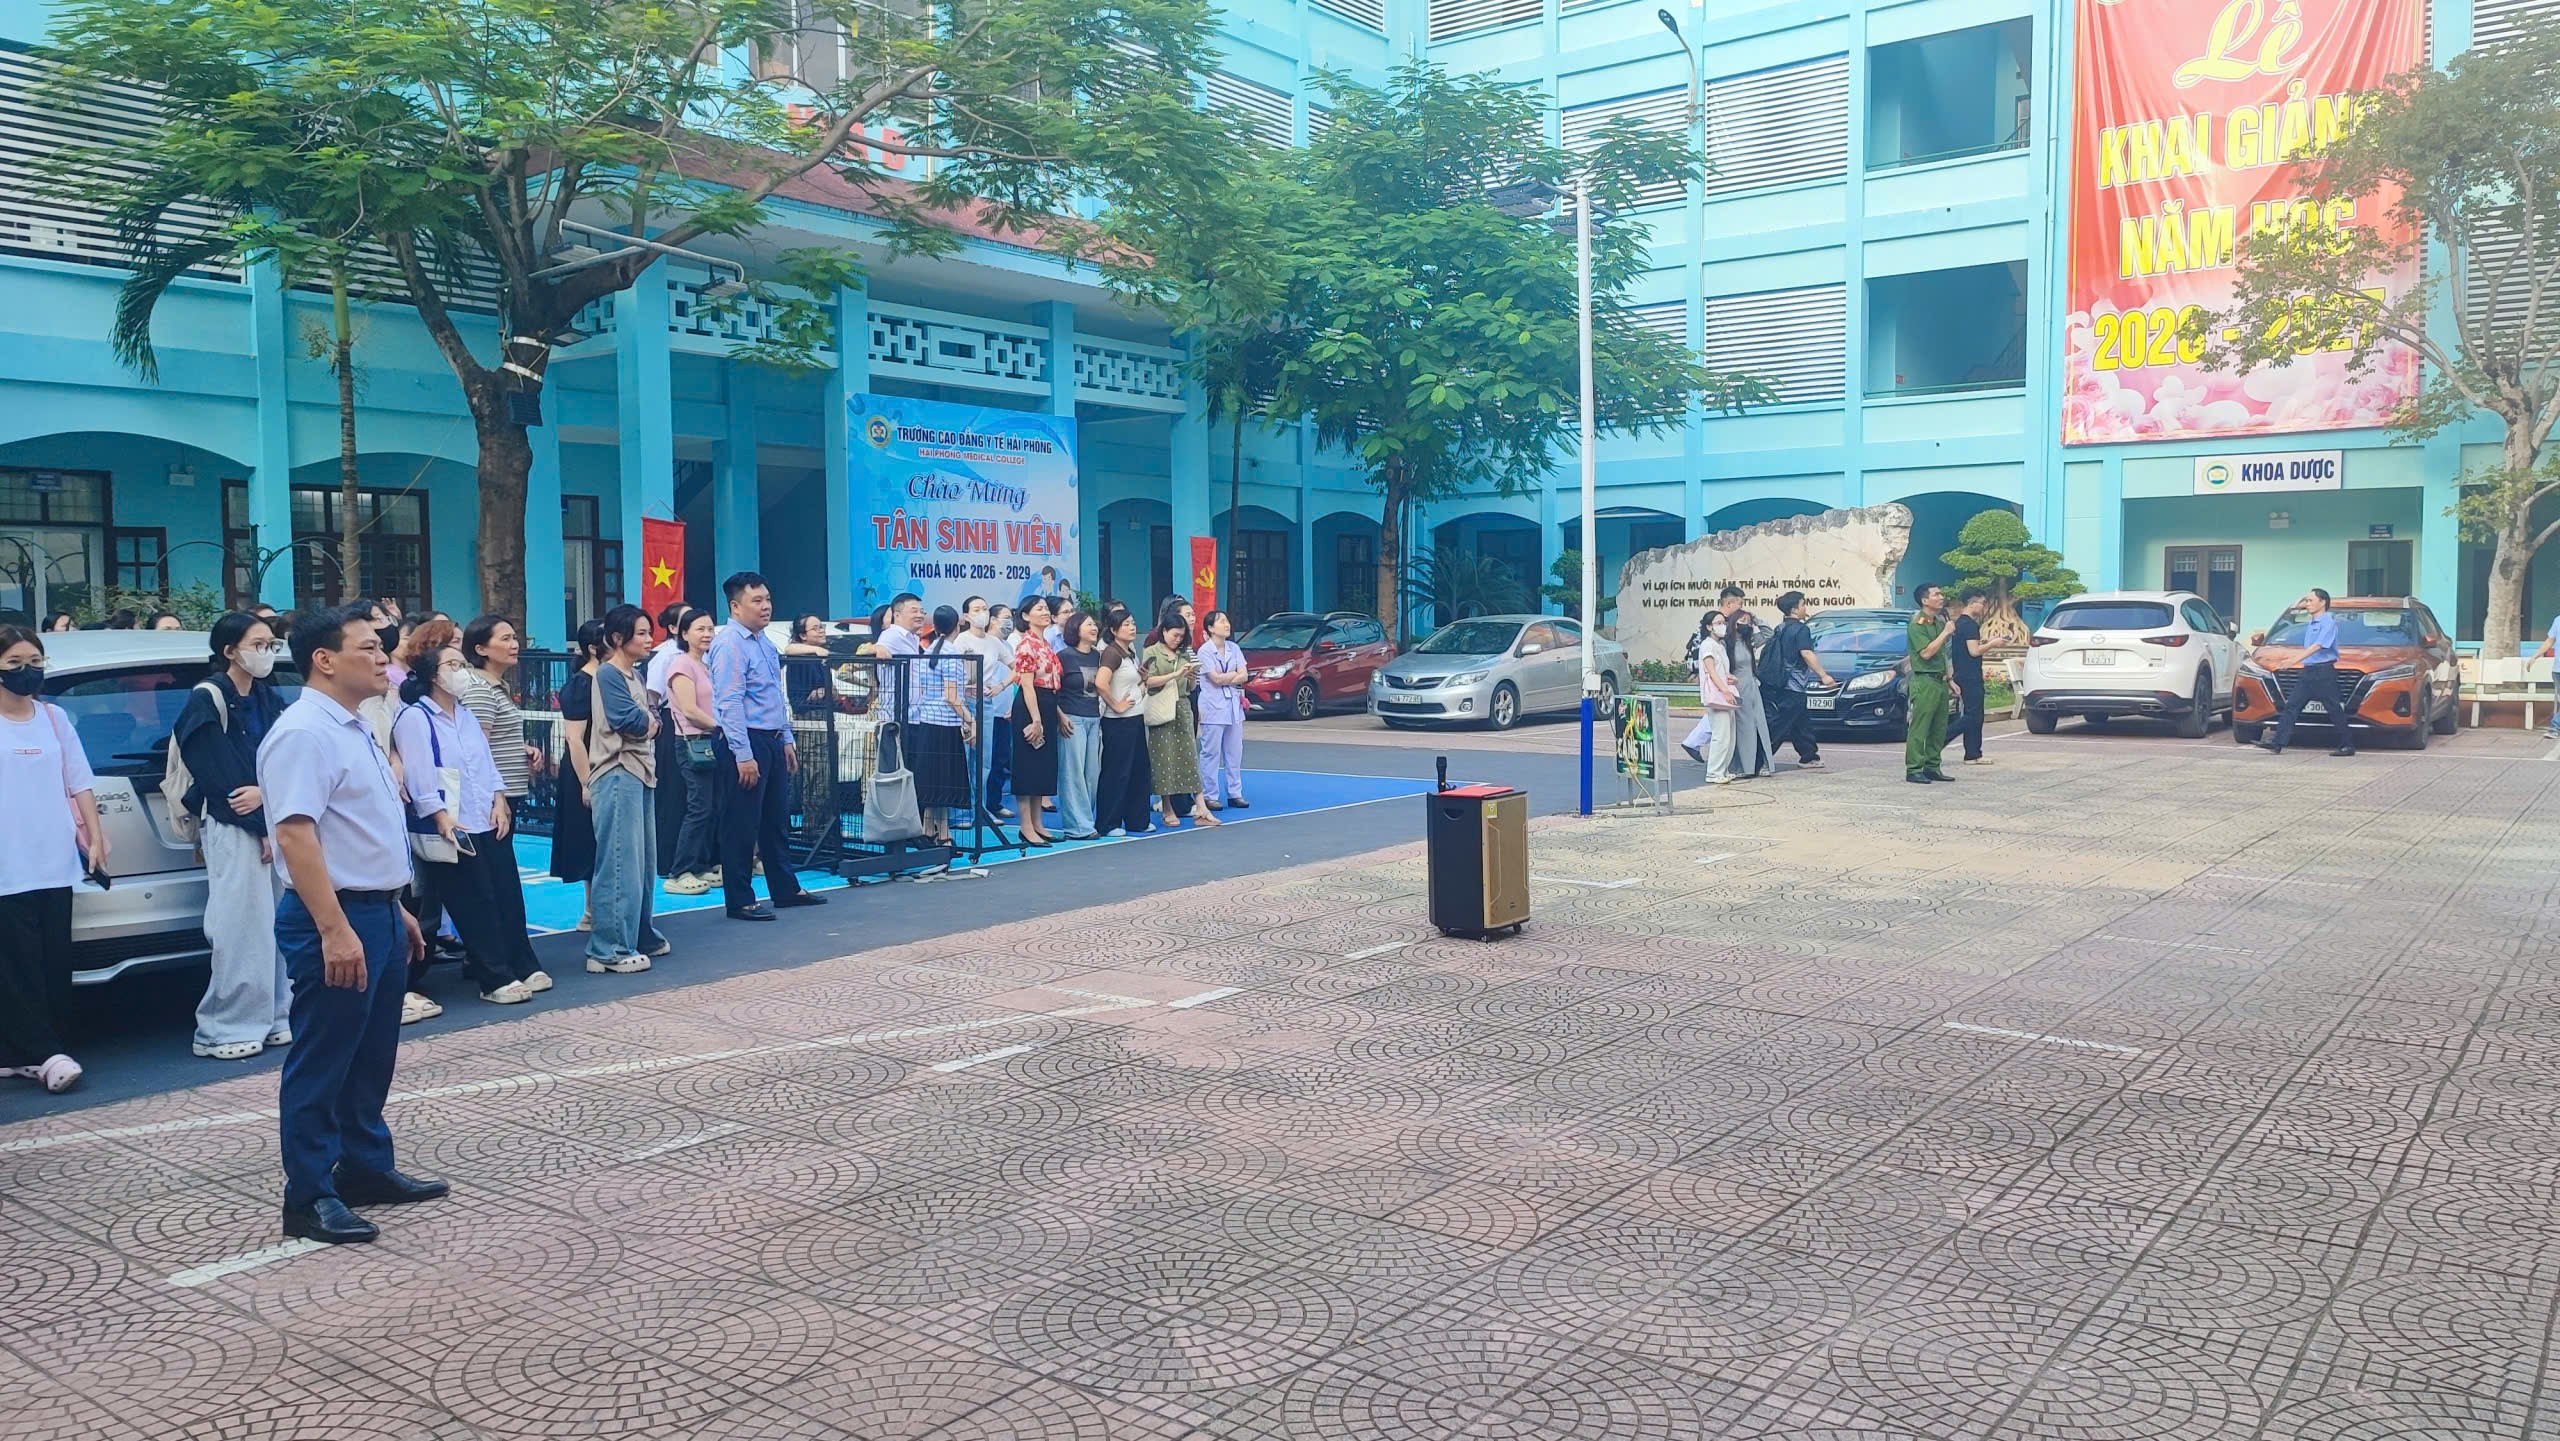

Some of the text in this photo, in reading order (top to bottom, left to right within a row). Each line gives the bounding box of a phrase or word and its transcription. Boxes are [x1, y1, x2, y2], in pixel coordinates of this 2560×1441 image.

[2098, 112, 2211, 188] KHAI
[2120, 199, 2236, 279] NĂM
[938, 430, 957, 445] CAO
[986, 436, 992, 448] Y
[935, 450, 961, 459] PHONG
[963, 452, 994, 462] MEDICAL
[996, 455, 1025, 465] COLLEGE
[2242, 458, 2335, 483] KHOA DƯỢC
[908, 473, 1029, 511] Chào Mừng
[872, 508, 1062, 554] TÂN SINH VIÊN
[945, 564, 967, 582] HỌC
[970, 564, 996, 579] 2026
[1006, 565, 1031, 580] 2029
[1642, 579, 1652, 591] VÌ
[1654, 580, 1668, 592] LỢI
[1670, 579, 1685, 591] ÍCH
[1739, 578, 1754, 589] THÌ
[1756, 576, 1779, 589] PHẢI
[1642, 596, 1651, 607] VÌ
[1654, 598, 1668, 609] LỢI
[1670, 597, 1685, 607] ÍCH
[1743, 596, 1757, 607] THÌ
